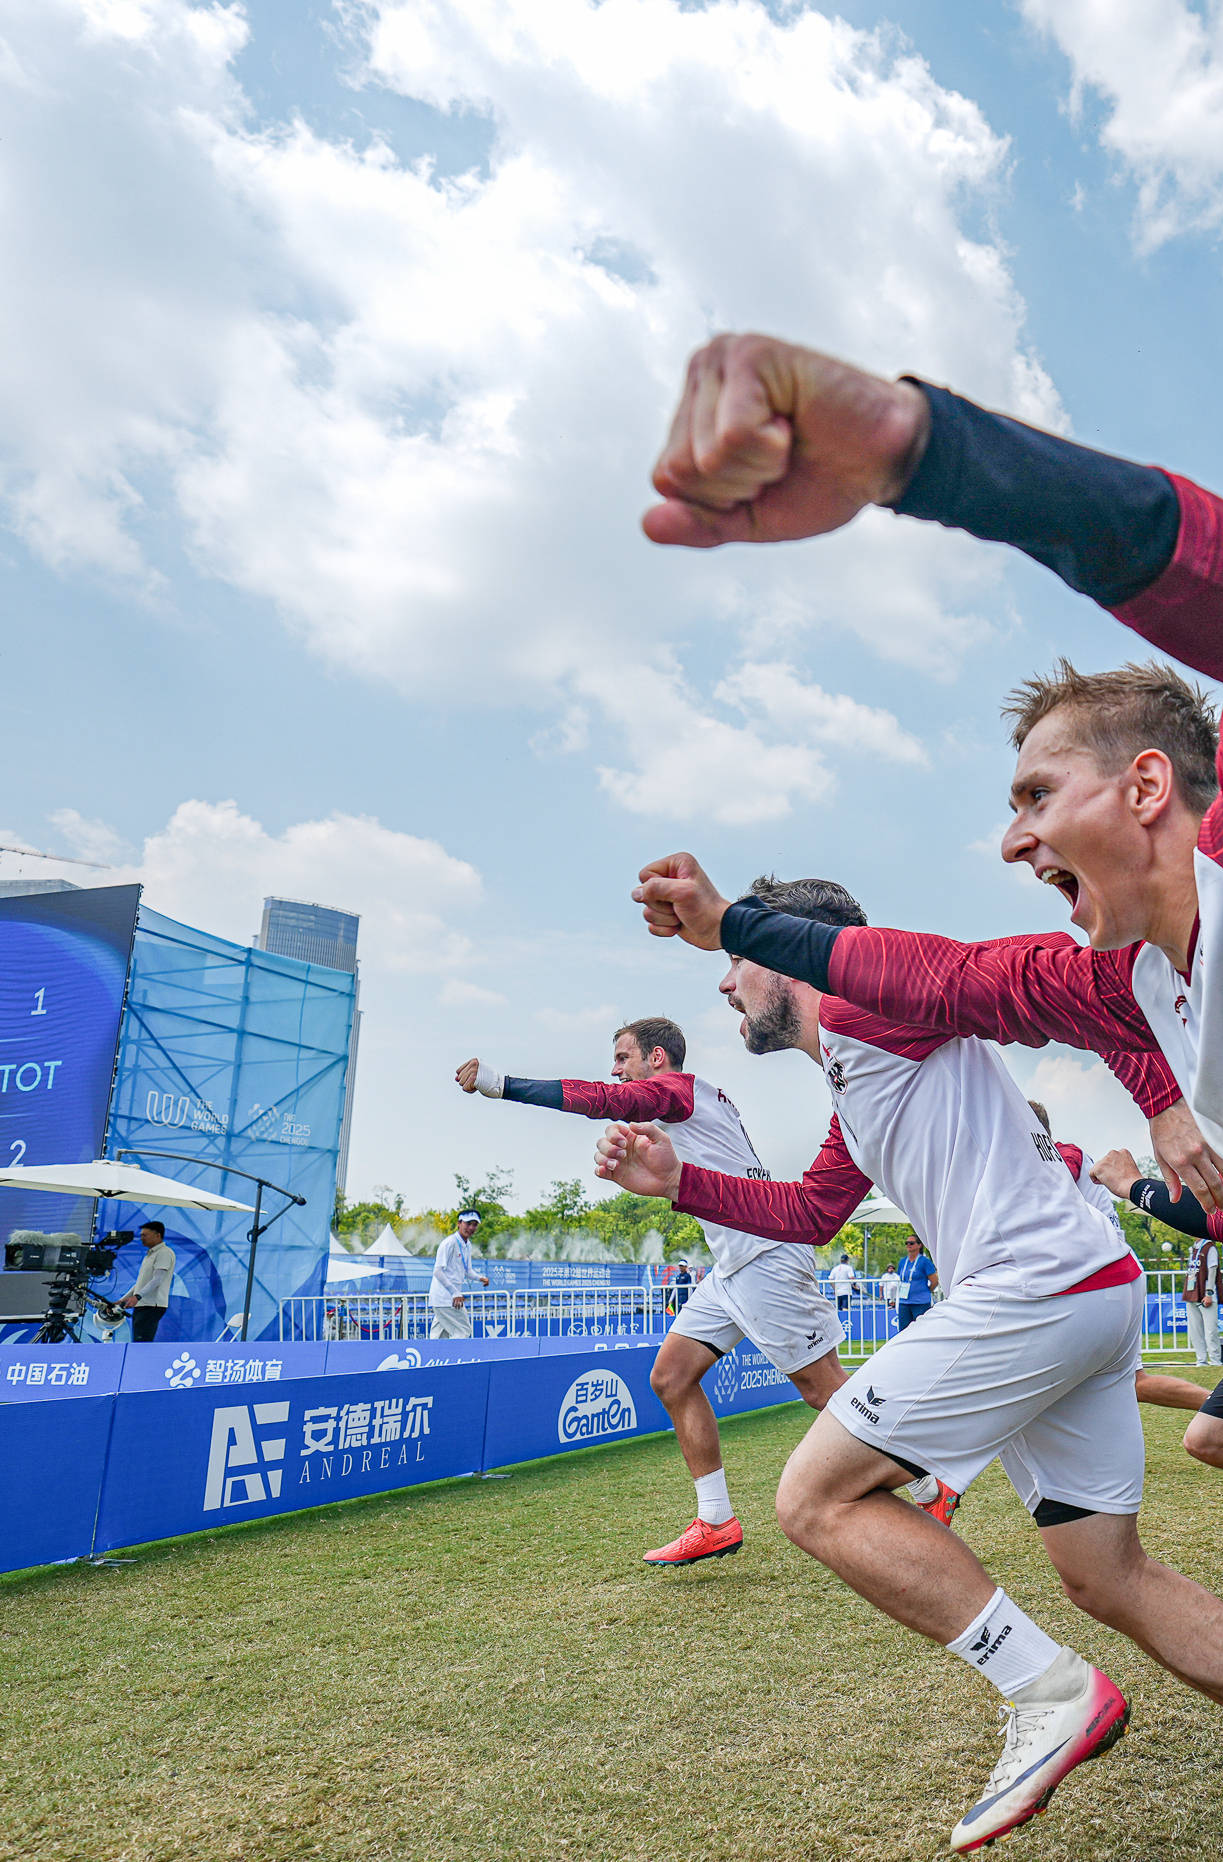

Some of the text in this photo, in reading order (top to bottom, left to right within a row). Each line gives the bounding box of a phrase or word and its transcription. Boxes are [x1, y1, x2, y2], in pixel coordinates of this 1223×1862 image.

[30, 986, 47, 1016] 1
[0, 1060, 63, 1094] TOT
[190, 1121, 228, 1136] GAMES
[193, 1110, 230, 1124] WORLD
[280, 1122, 312, 1137] 2025
[8, 1139, 27, 1169] 2
[807, 1337, 824, 1350] erima
[6, 1362, 90, 1386] 中国石油
[204, 1358, 283, 1384] 智扬体育
[741, 1354, 753, 1367] THE
[574, 1378, 619, 1405] 百岁山
[740, 1370, 763, 1390] 2025
[562, 1398, 632, 1441] Ganten
[850, 1396, 881, 1426] erima
[300, 1395, 434, 1457] 安德瑞尔
[299, 1440, 425, 1485] ANDREAL
[976, 1623, 1013, 1667] erima
